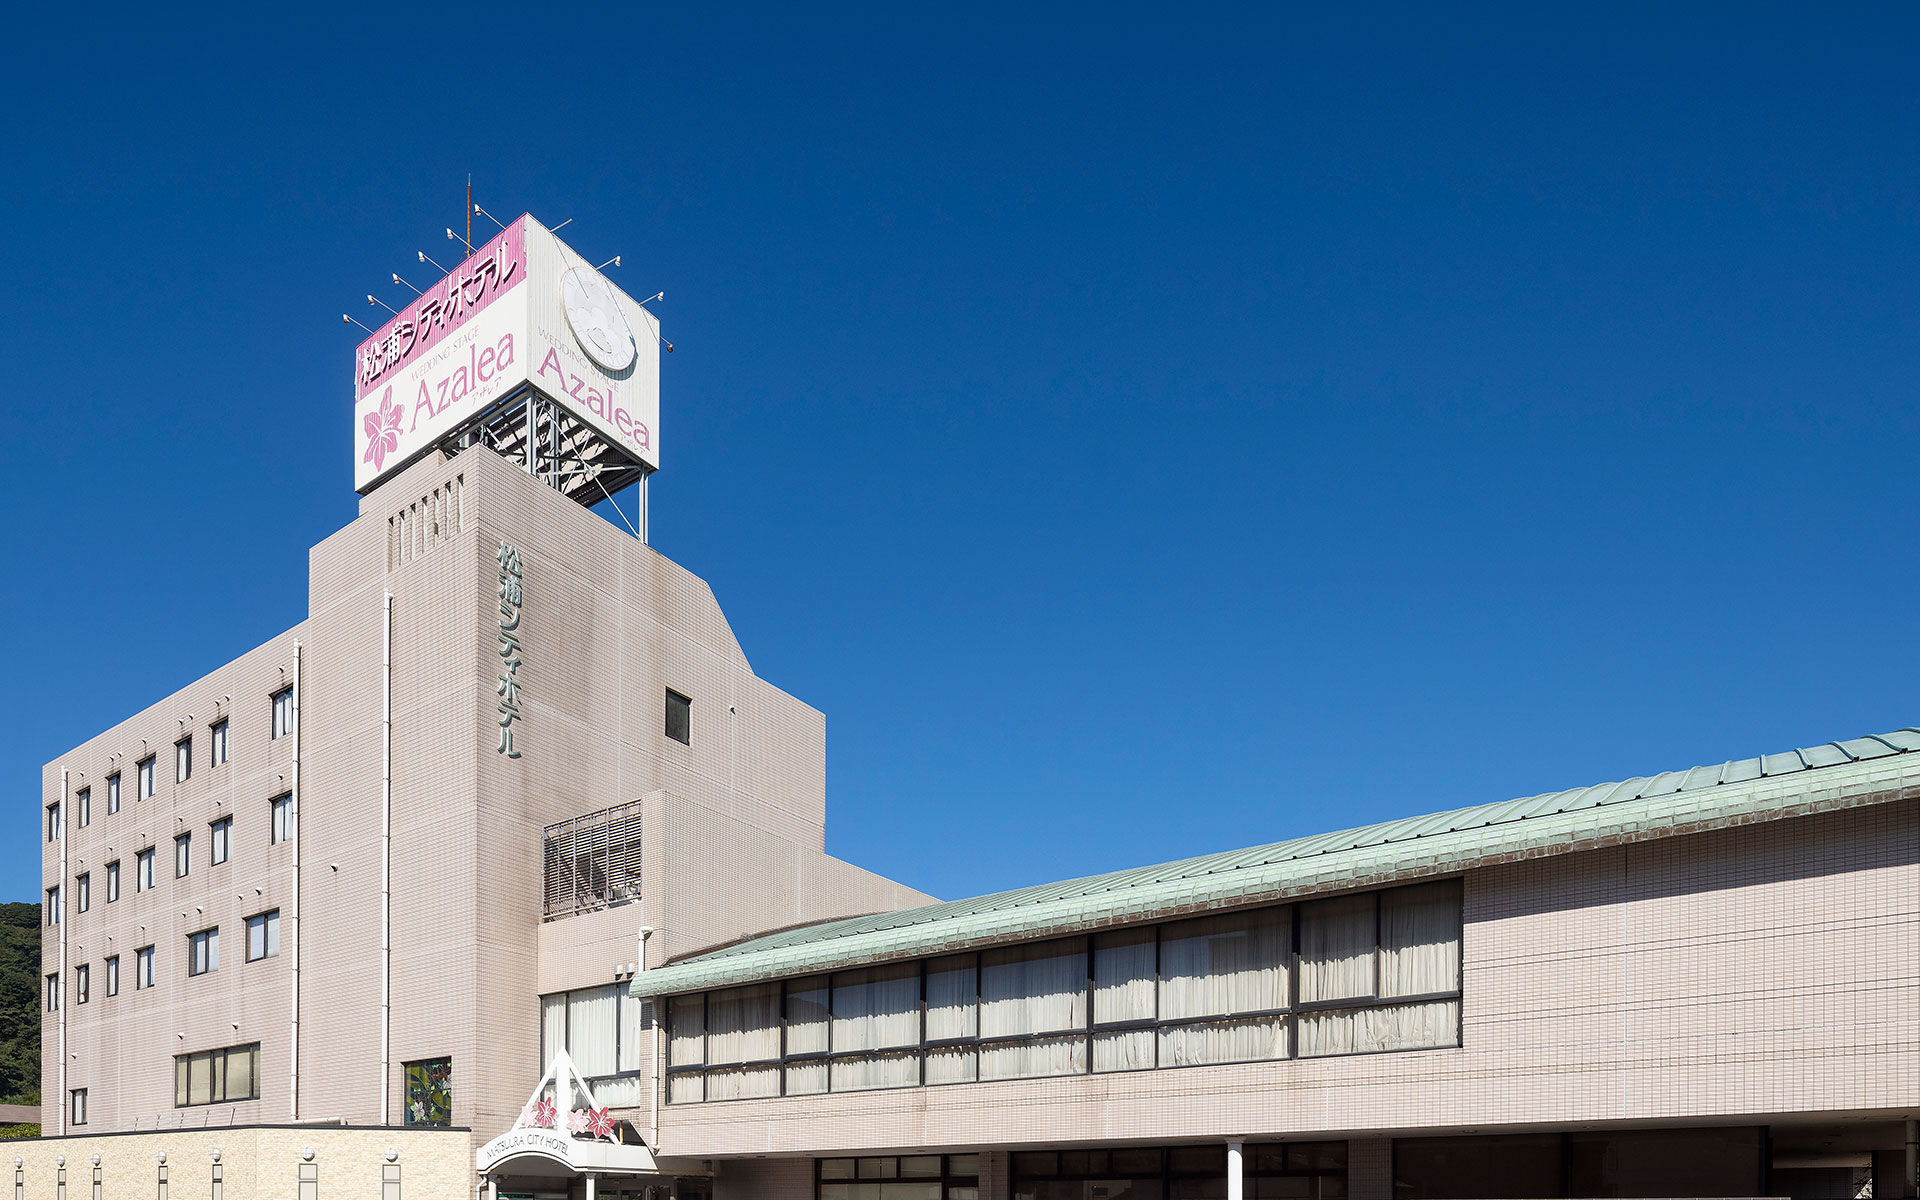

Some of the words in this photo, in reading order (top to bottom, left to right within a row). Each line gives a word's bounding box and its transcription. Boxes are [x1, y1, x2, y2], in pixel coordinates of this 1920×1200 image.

[359, 240, 518, 387] 松浦シティホテル
[411, 346, 450, 382] WEDDING
[453, 324, 479, 352] STAGE
[537, 325, 587, 369] WEDDING
[590, 364, 619, 392] STAGE
[410, 333, 515, 433] Azalea
[537, 346, 650, 451] Azalea
[497, 539, 523, 759] 松浦シティホテル
[527, 1134, 545, 1145] CITY
[545, 1136, 569, 1156] HOTEL
